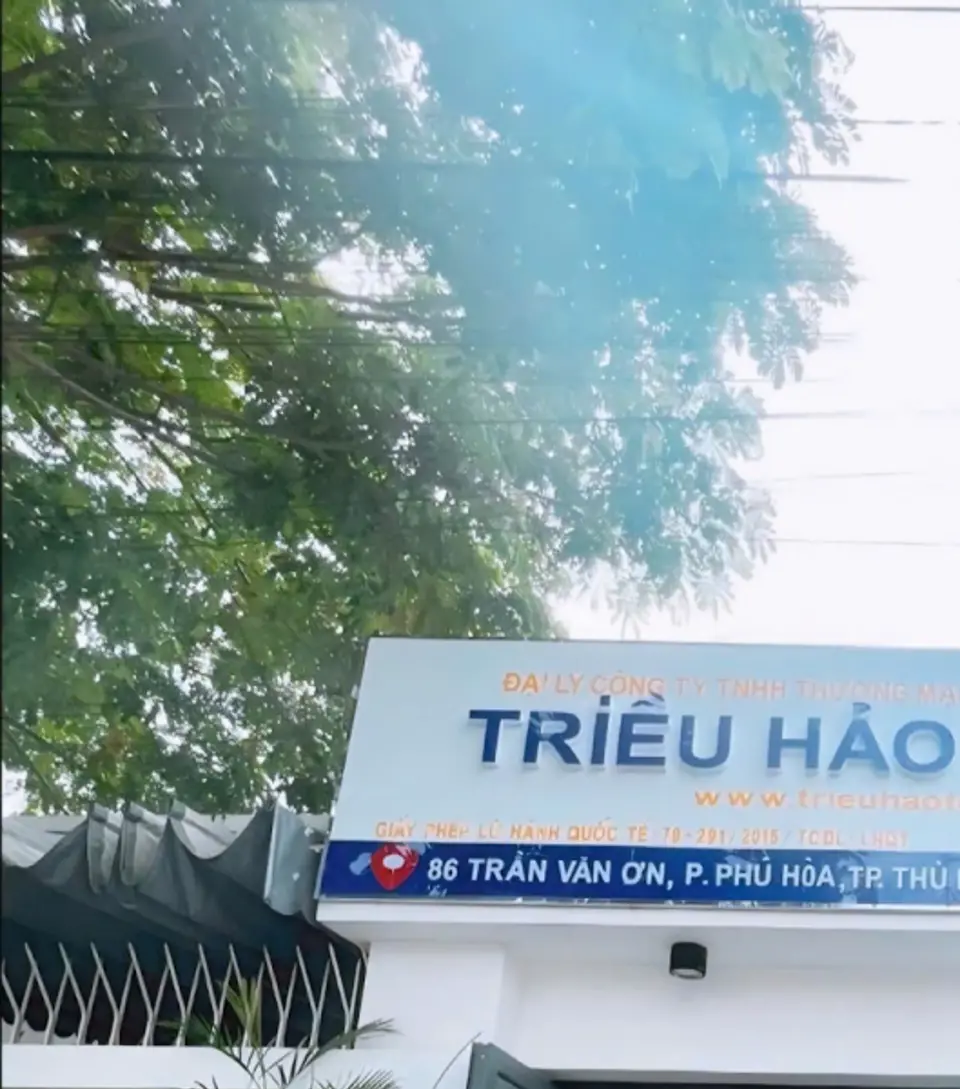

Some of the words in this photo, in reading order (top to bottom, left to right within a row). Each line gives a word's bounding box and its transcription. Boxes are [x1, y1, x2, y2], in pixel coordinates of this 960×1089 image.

[676, 677, 708, 697] TY
[718, 677, 786, 699] TNHH
[767, 702, 956, 773] HẢO
[427, 858, 458, 881] 86
[558, 856, 611, 885] VĂN
[621, 860, 674, 890] ƠN,
